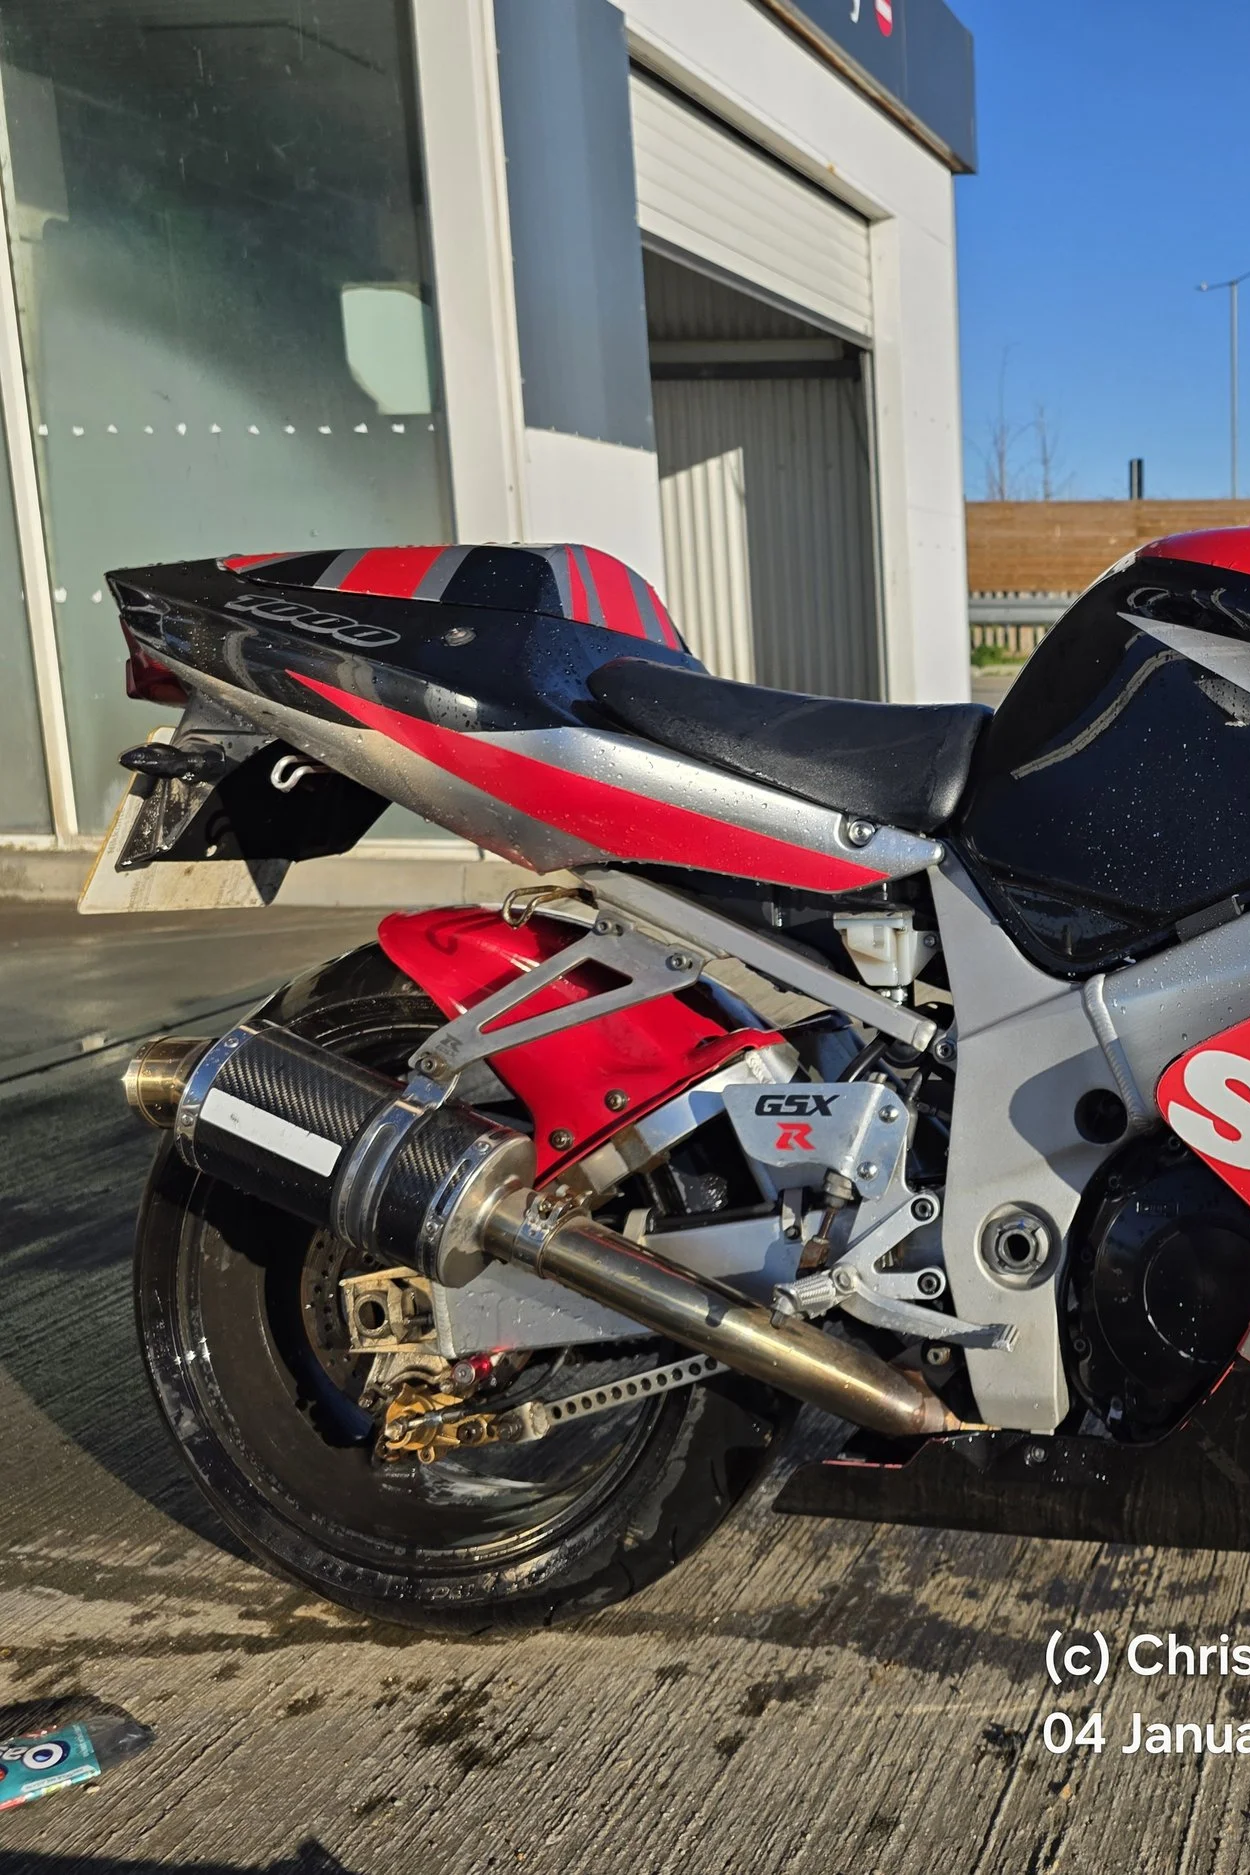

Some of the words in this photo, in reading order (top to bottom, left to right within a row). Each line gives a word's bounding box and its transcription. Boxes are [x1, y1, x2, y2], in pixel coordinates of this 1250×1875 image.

[224, 594, 402, 648] 1000
[755, 1094, 840, 1117] GSX
[775, 1122, 816, 1151] R
